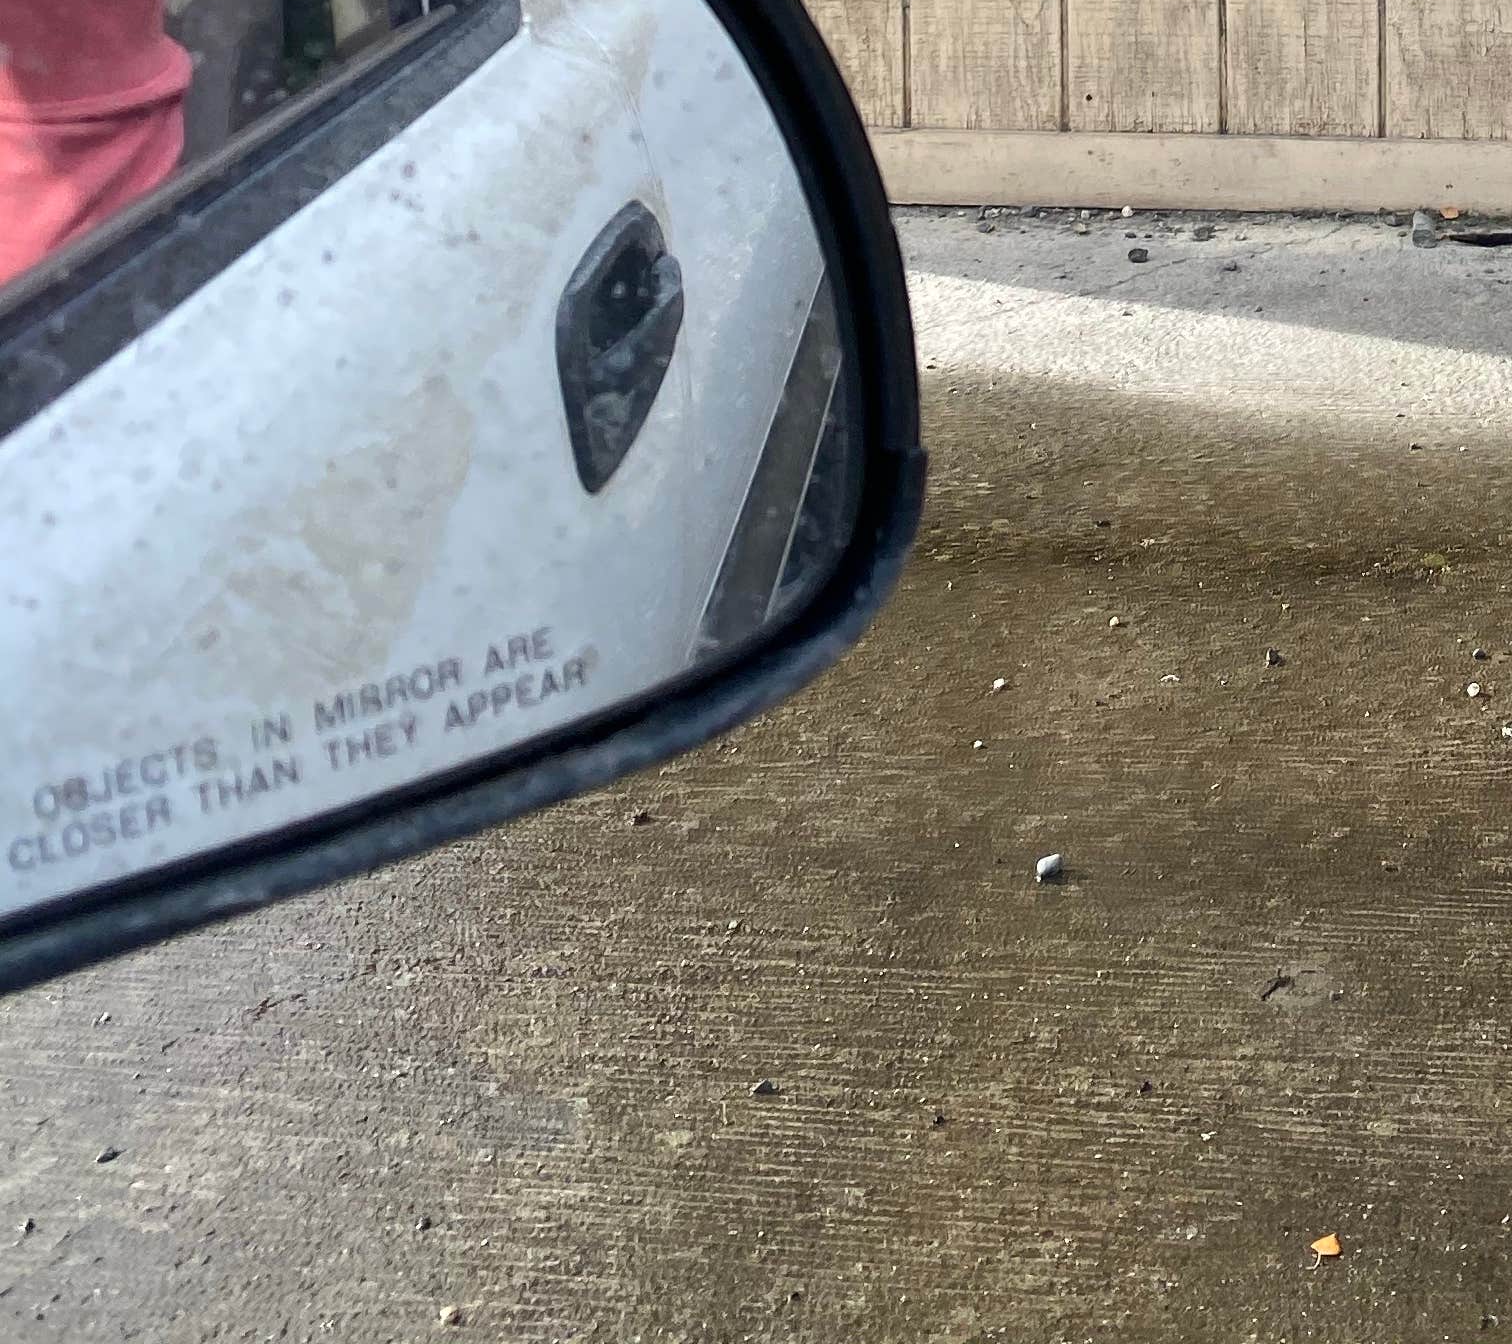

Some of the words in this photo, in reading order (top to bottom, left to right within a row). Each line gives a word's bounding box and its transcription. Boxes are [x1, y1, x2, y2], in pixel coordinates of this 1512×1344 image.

[8, 794, 172, 871] CLOSER
[194, 755, 301, 814] THAN
[323, 713, 417, 771] THEY
[445, 654, 587, 733] APPEAR
[33, 736, 219, 820] OBJECTS
[250, 711, 291, 752] IN
[314, 657, 462, 735] MIRROR
[485, 626, 554, 676] ARE
